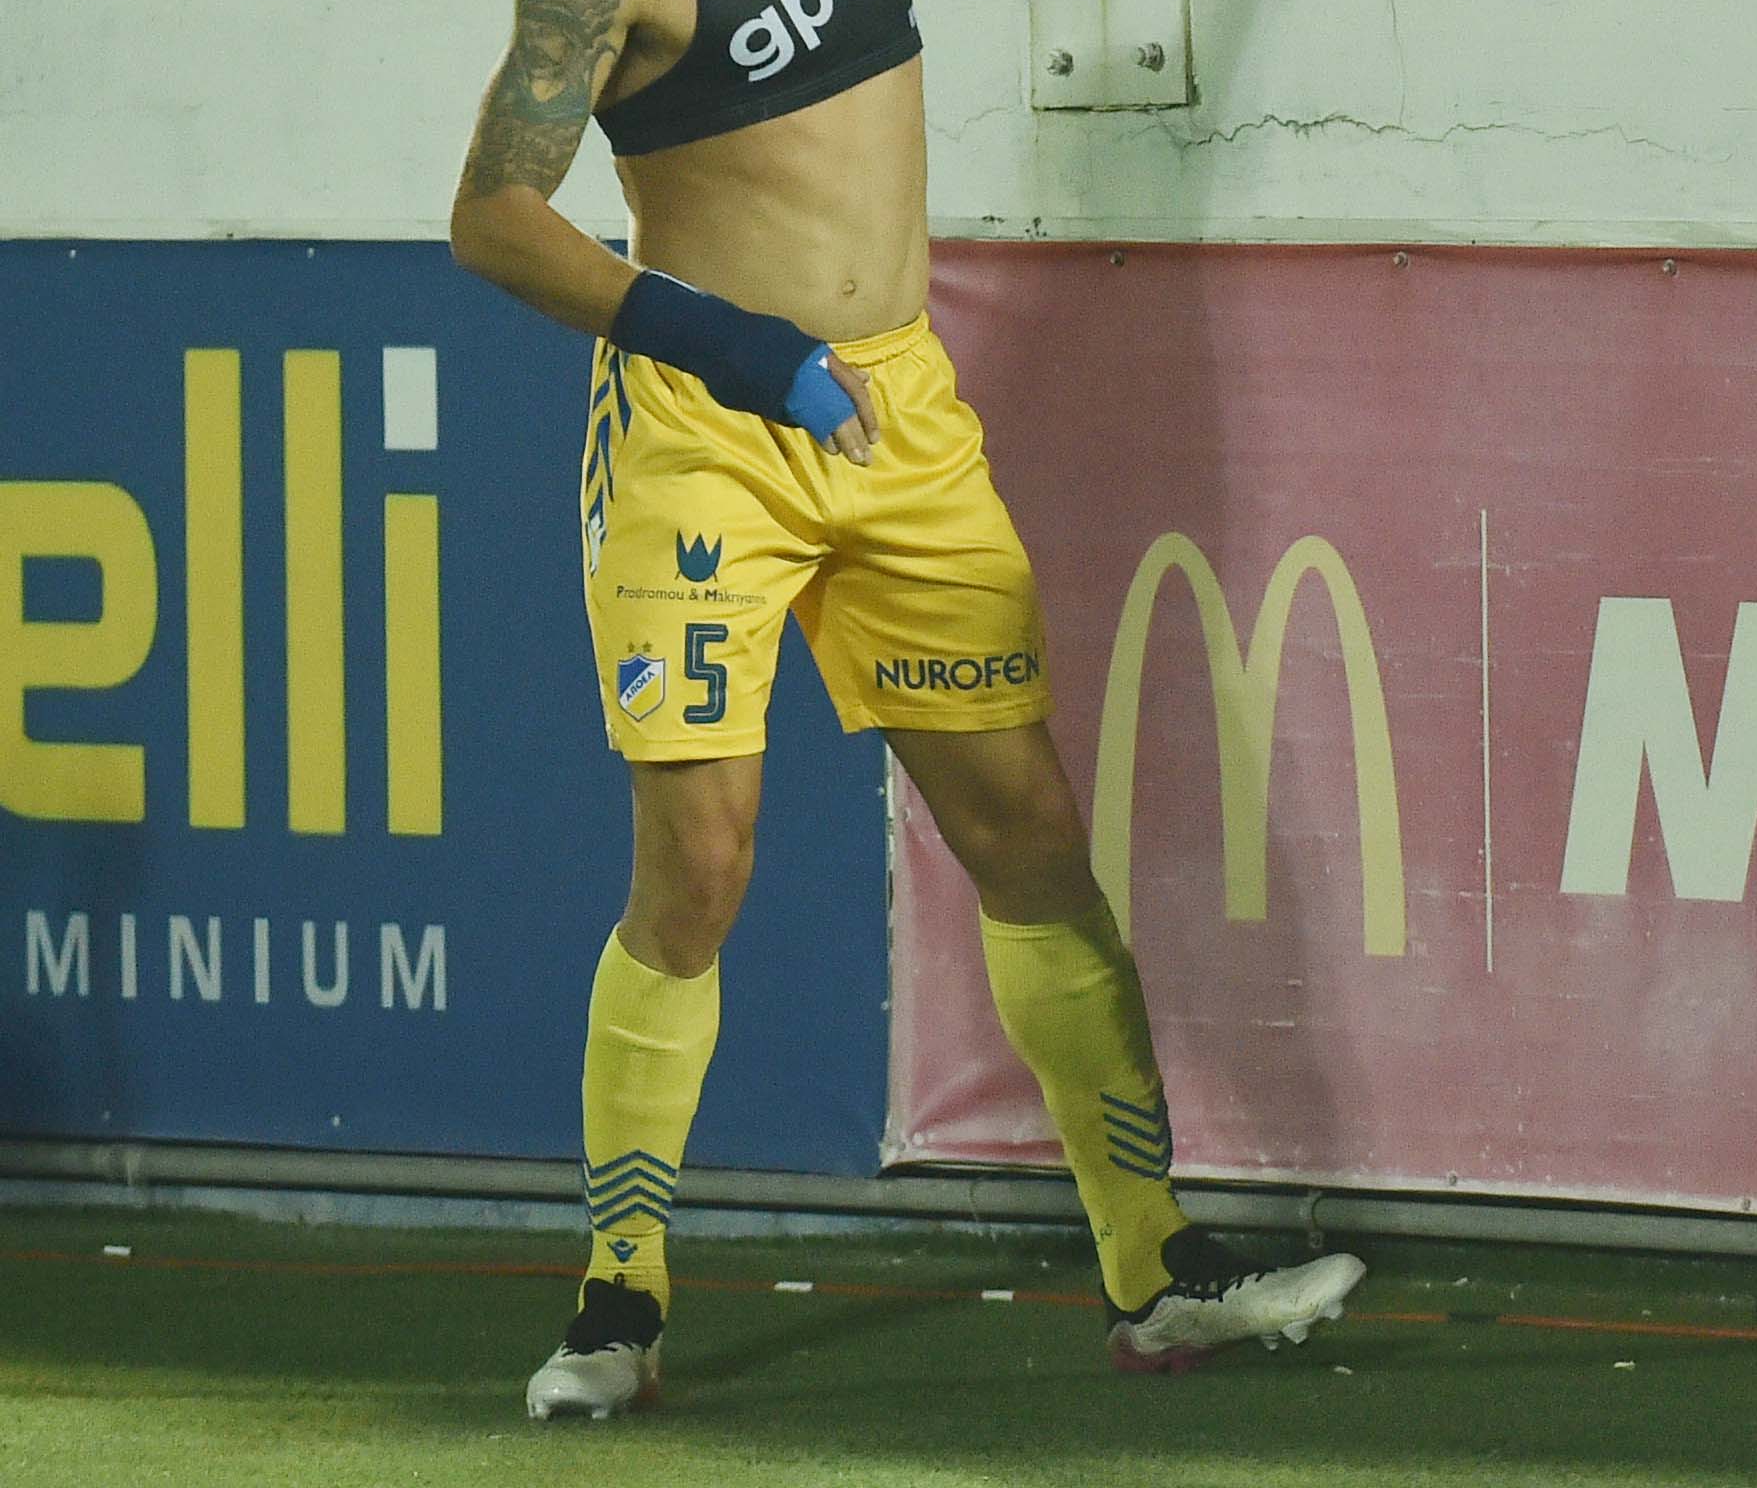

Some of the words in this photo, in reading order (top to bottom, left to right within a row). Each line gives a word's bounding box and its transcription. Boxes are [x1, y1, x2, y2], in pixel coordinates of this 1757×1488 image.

[683, 622, 729, 724] 5
[875, 650, 1040, 691] NUROFEN
[25, 911, 448, 1012] MINIUM
